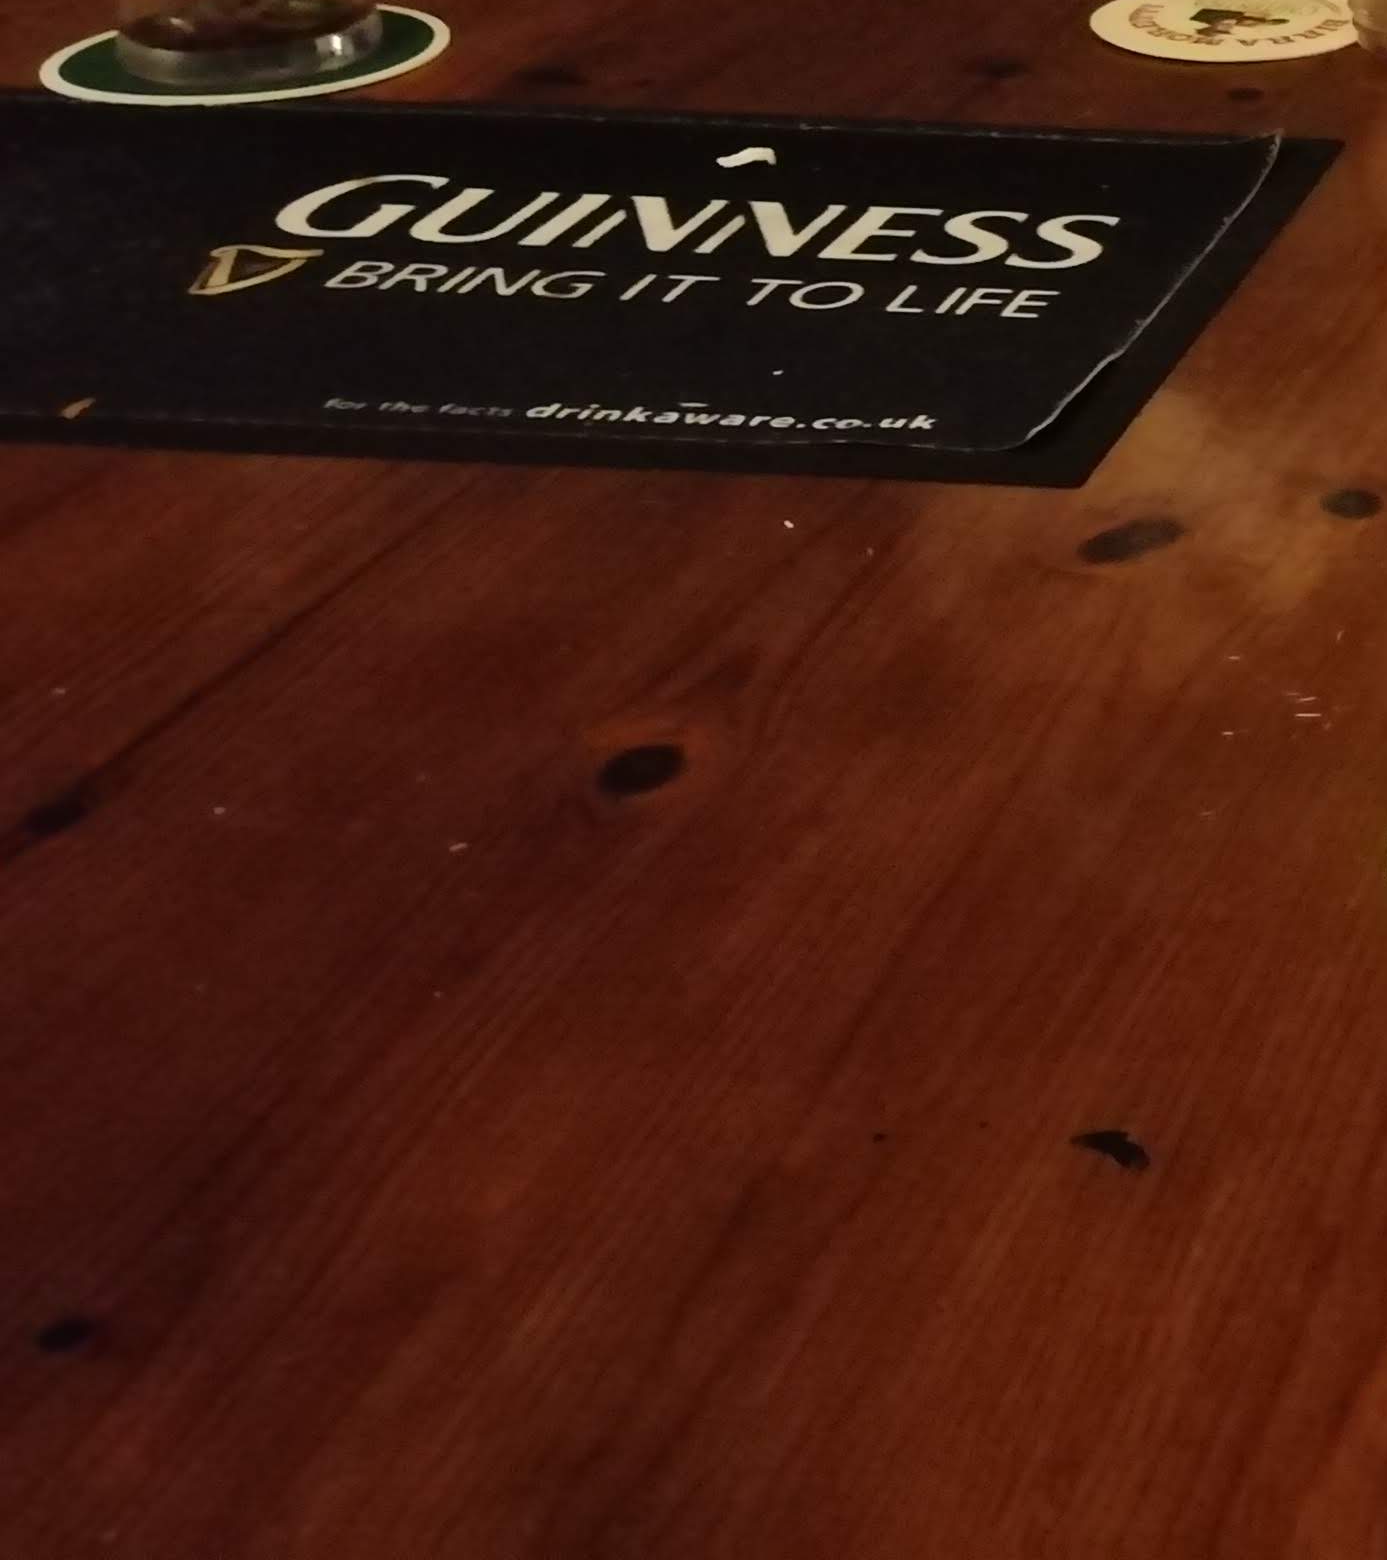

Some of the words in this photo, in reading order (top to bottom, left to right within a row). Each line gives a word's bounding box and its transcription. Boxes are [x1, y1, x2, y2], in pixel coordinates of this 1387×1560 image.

[274, 174, 1121, 270] GUINNESS
[323, 260, 607, 299] BRING
[619, 273, 721, 303] IT
[746, 278, 865, 310] TO
[885, 285, 1061, 319] LIFE
[525, 402, 938, 430] drinkaware.co.uk
